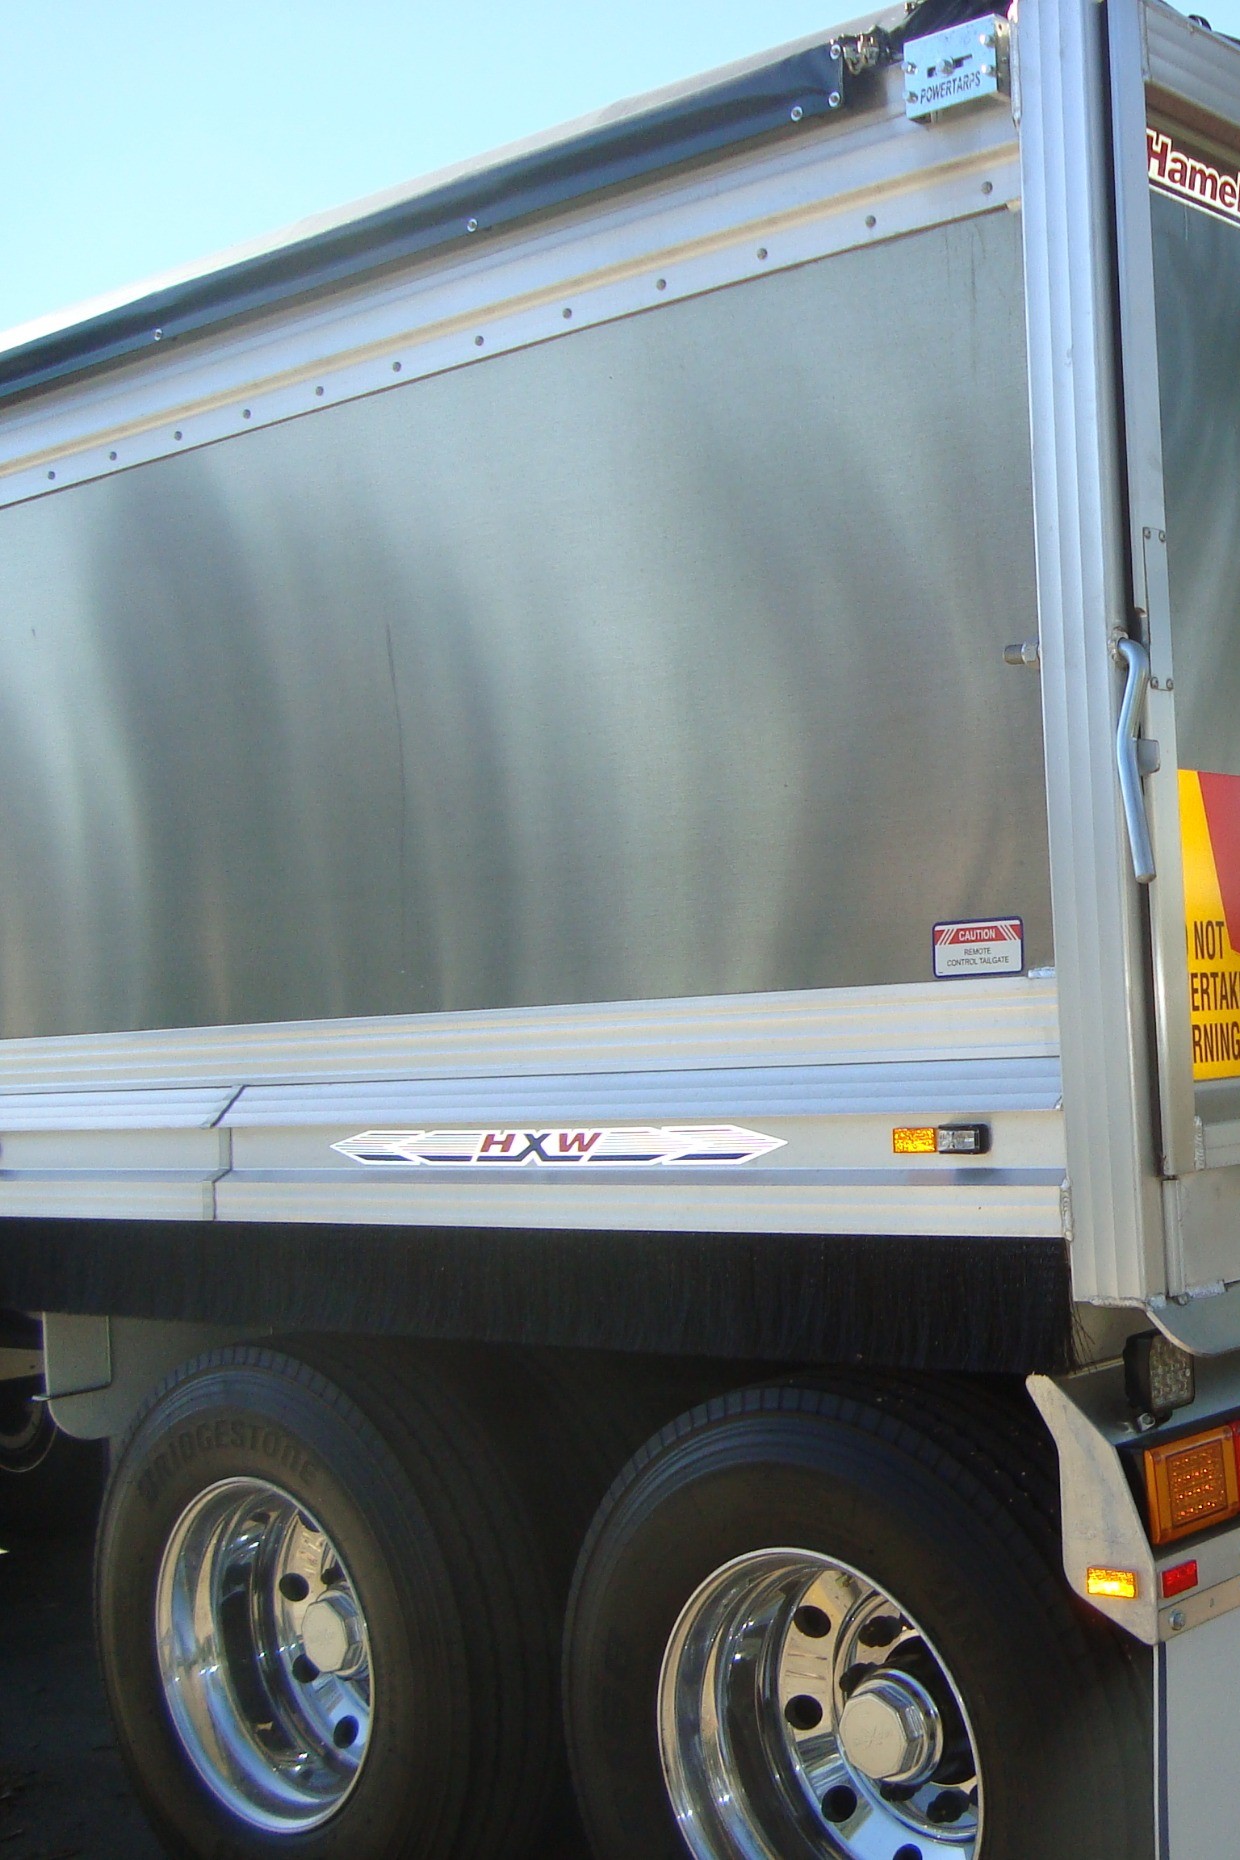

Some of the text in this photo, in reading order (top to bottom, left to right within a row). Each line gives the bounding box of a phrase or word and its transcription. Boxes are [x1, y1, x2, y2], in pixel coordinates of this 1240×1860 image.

[920, 71, 981, 104] POWERTARPS
[959, 928, 996, 941] CAUTION
[1193, 919, 1225, 961] NOT
[964, 947, 991, 956] REMOTE
[947, 956, 1009, 967] CONTROL TAILGATE
[480, 1132, 602, 1158] HXW
